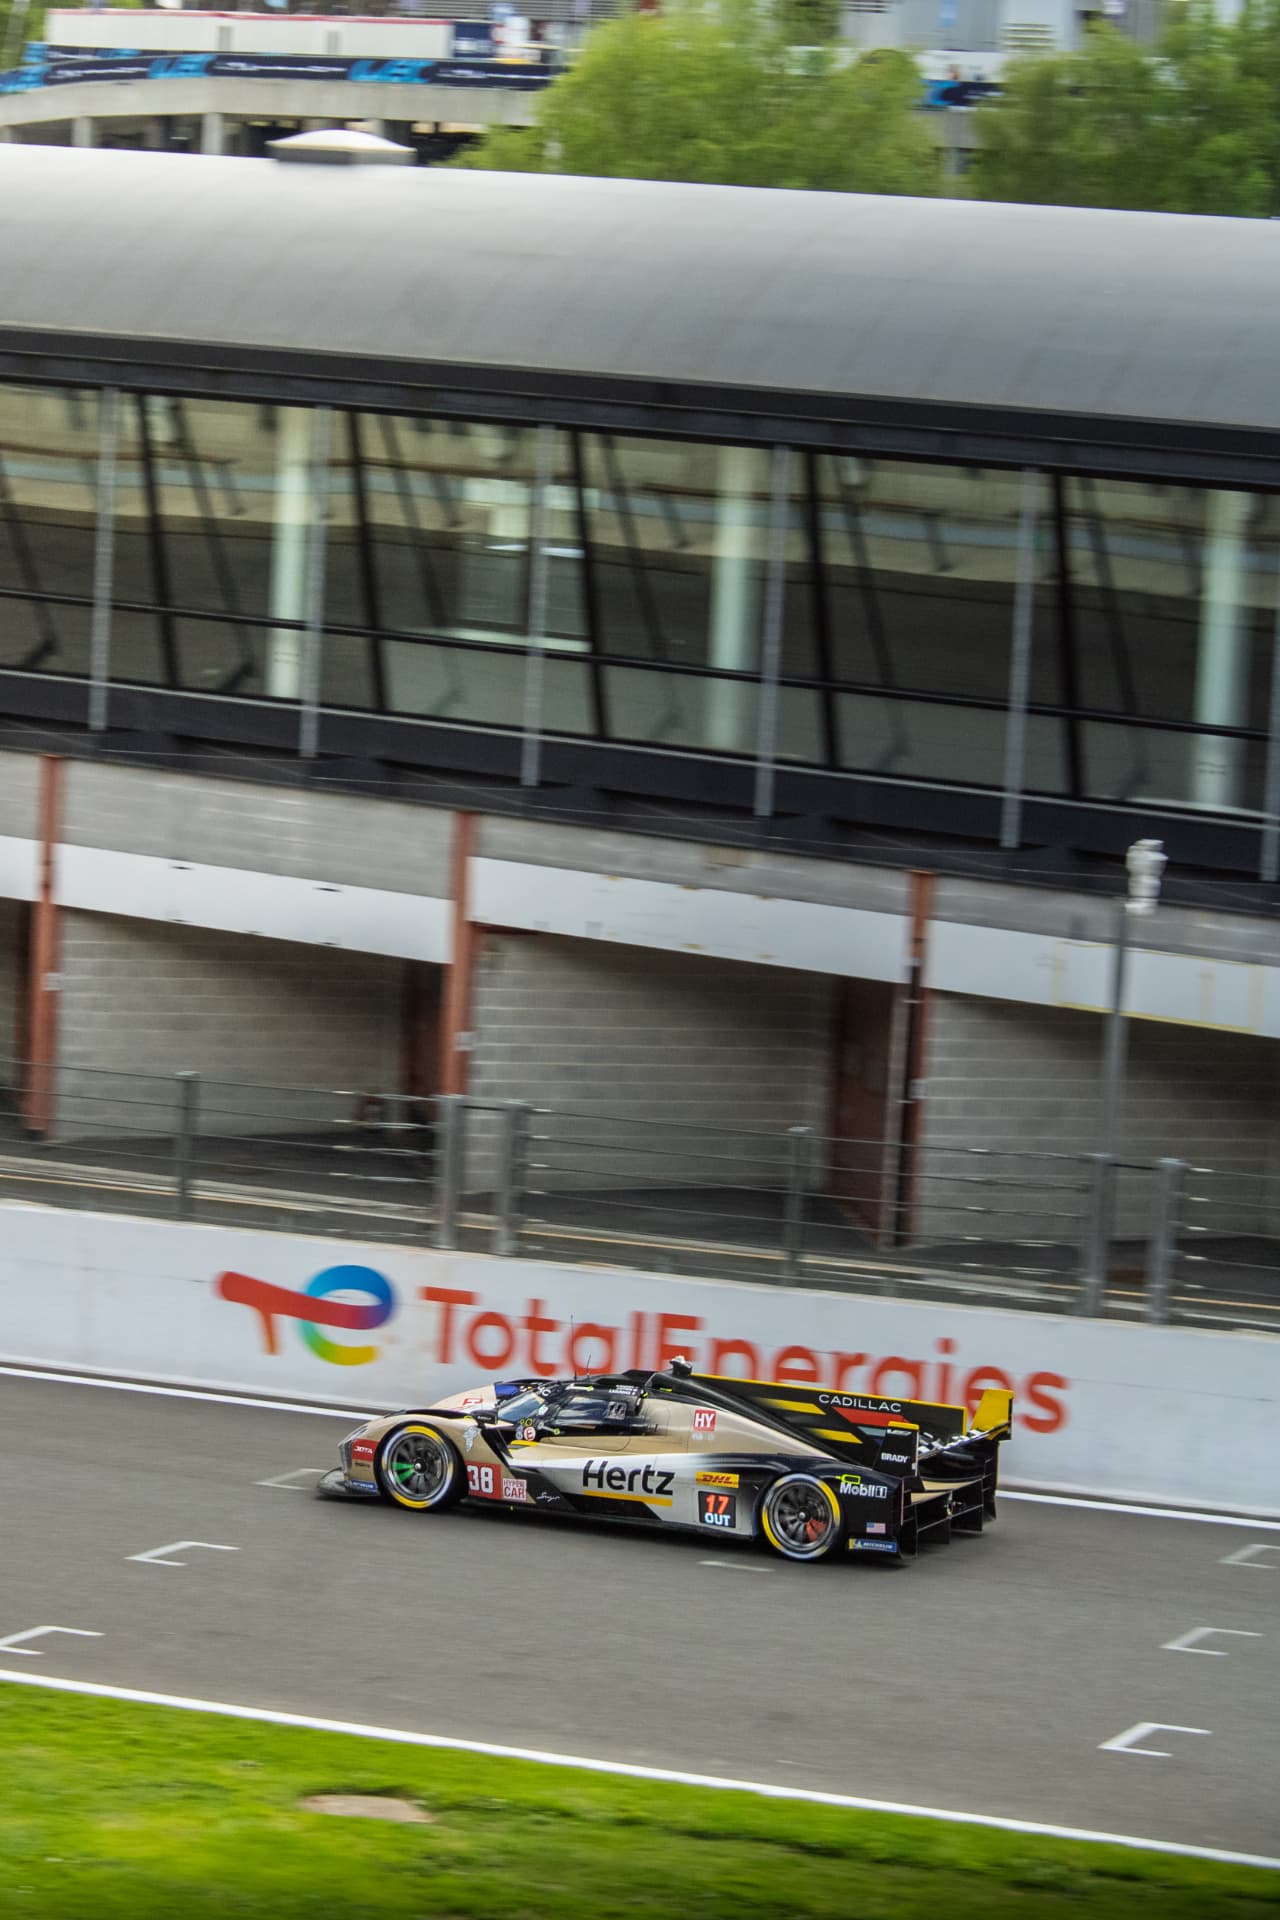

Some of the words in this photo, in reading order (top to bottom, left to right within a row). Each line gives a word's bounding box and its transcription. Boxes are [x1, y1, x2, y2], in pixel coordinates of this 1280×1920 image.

[420, 1286, 1069, 1434] TotalEnergies
[818, 1394, 902, 1413] CADILLAC
[694, 1412, 715, 1428] HY
[881, 1452, 908, 1463] BRADY
[466, 1464, 493, 1494] 38
[582, 1460, 675, 1496] Hertz
[702, 1474, 733, 1485] DHL
[504, 1486, 526, 1499] CAR
[705, 1493, 730, 1515] 17
[704, 1512, 731, 1526] OUT
